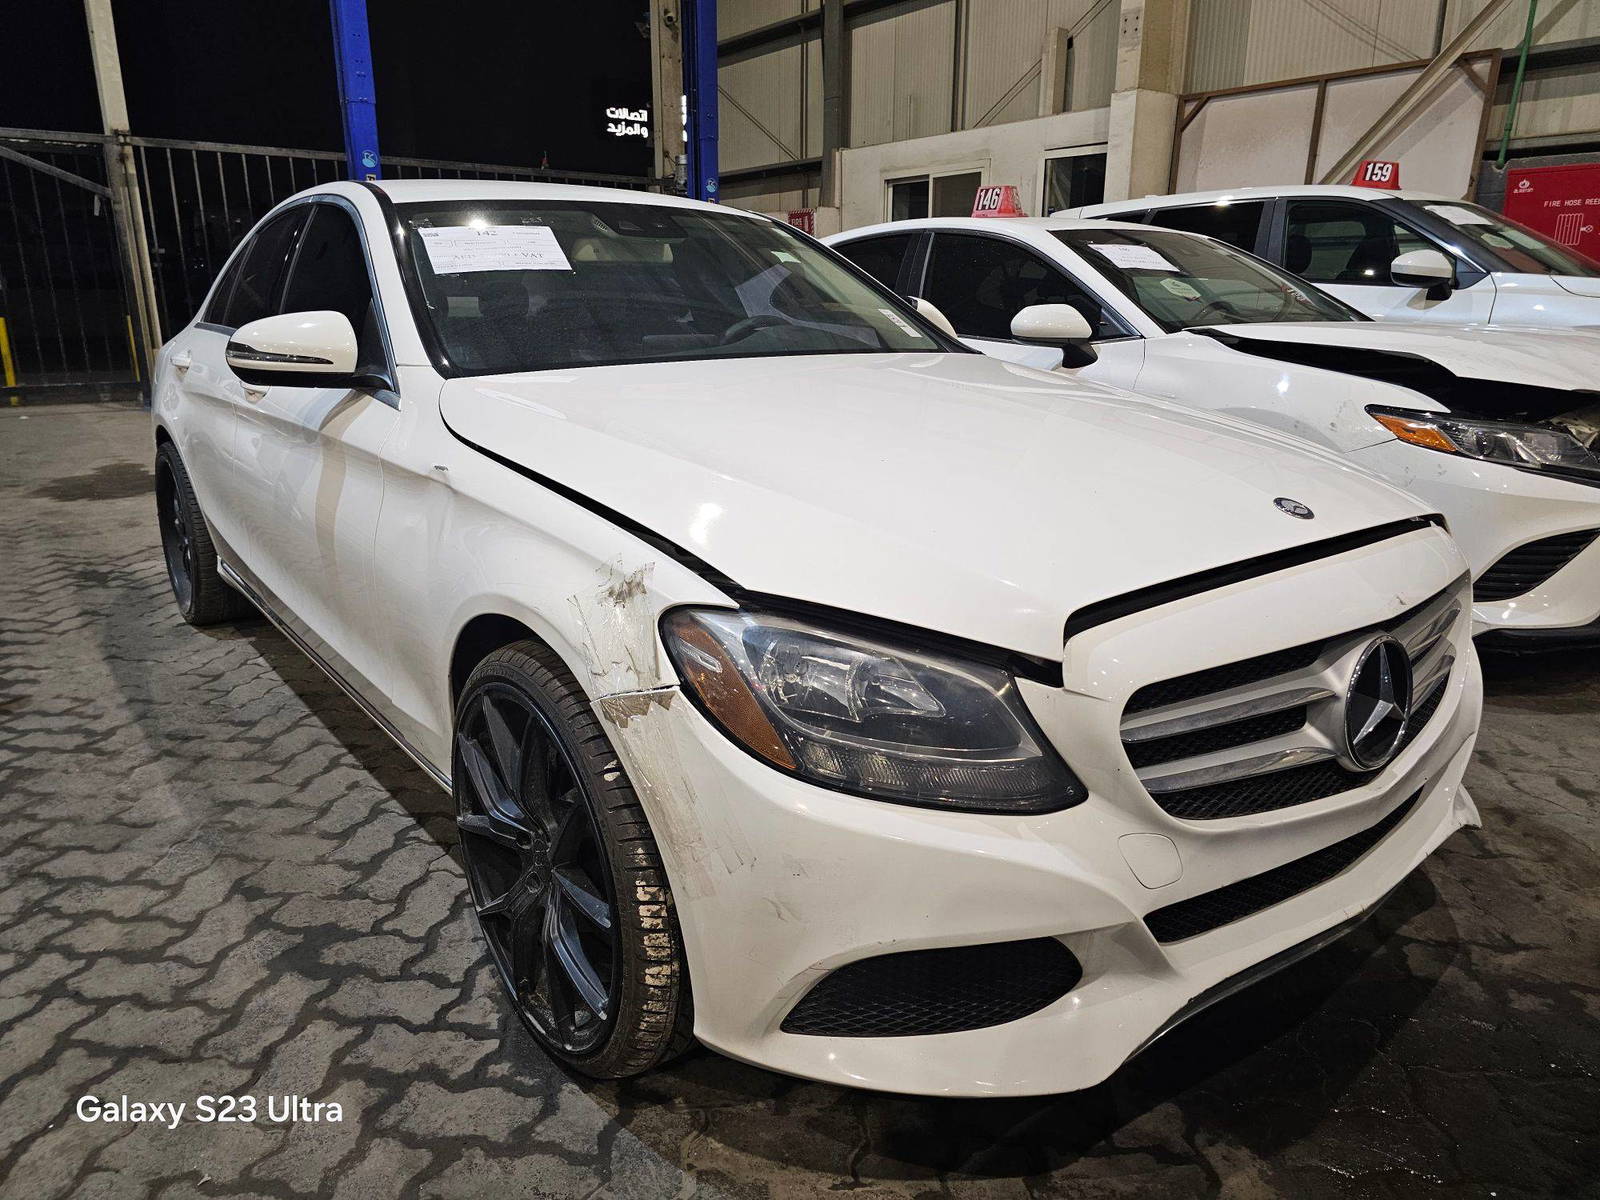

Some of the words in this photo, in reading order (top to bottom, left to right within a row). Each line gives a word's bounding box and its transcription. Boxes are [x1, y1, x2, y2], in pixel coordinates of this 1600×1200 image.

[606, 107, 648, 122] اتصالات
[607, 122, 649, 138] والمزيد
[1365, 163, 1392, 181] 159
[978, 188, 1000, 210] 146
